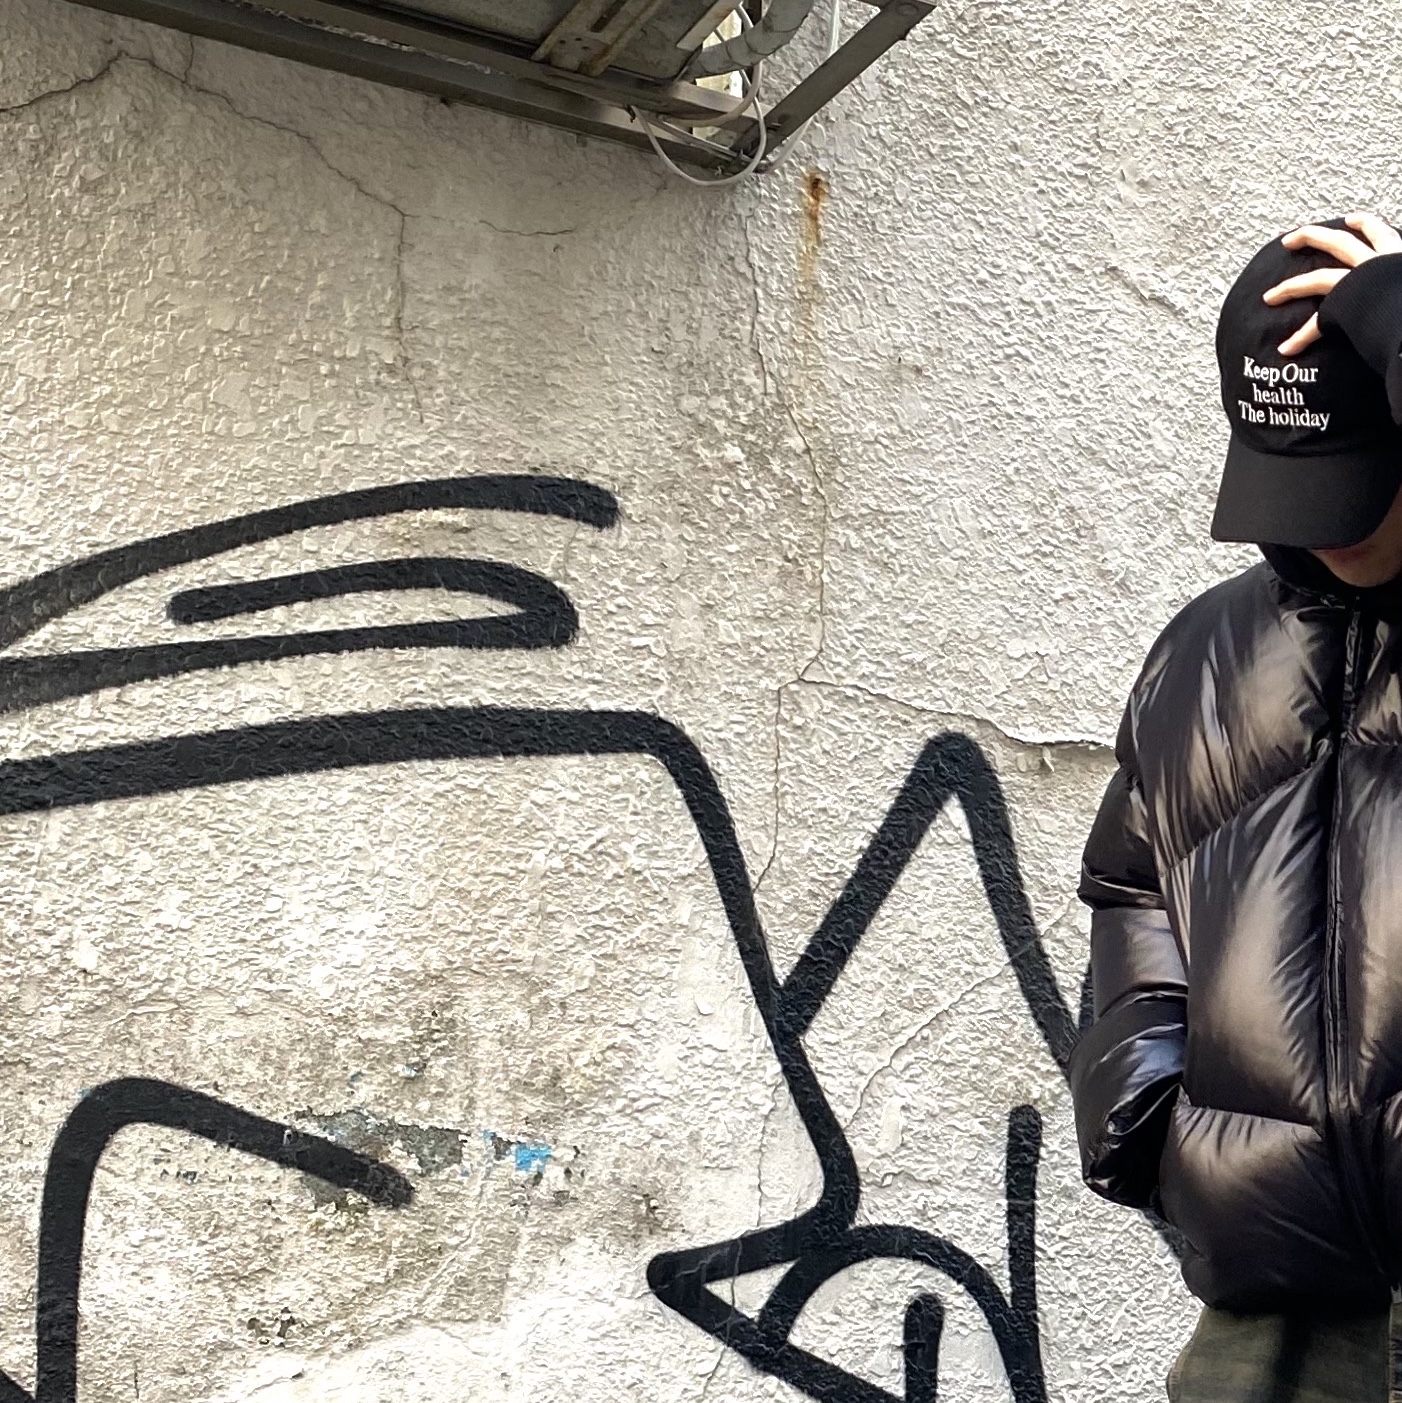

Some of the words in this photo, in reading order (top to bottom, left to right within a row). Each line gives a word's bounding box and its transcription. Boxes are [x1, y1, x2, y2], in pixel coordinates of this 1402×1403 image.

[1243, 355, 1280, 387] Keep
[1282, 363, 1319, 383] Our
[1252, 382, 1305, 406] health
[1237, 399, 1266, 423] The
[1268, 406, 1331, 431] holiday
